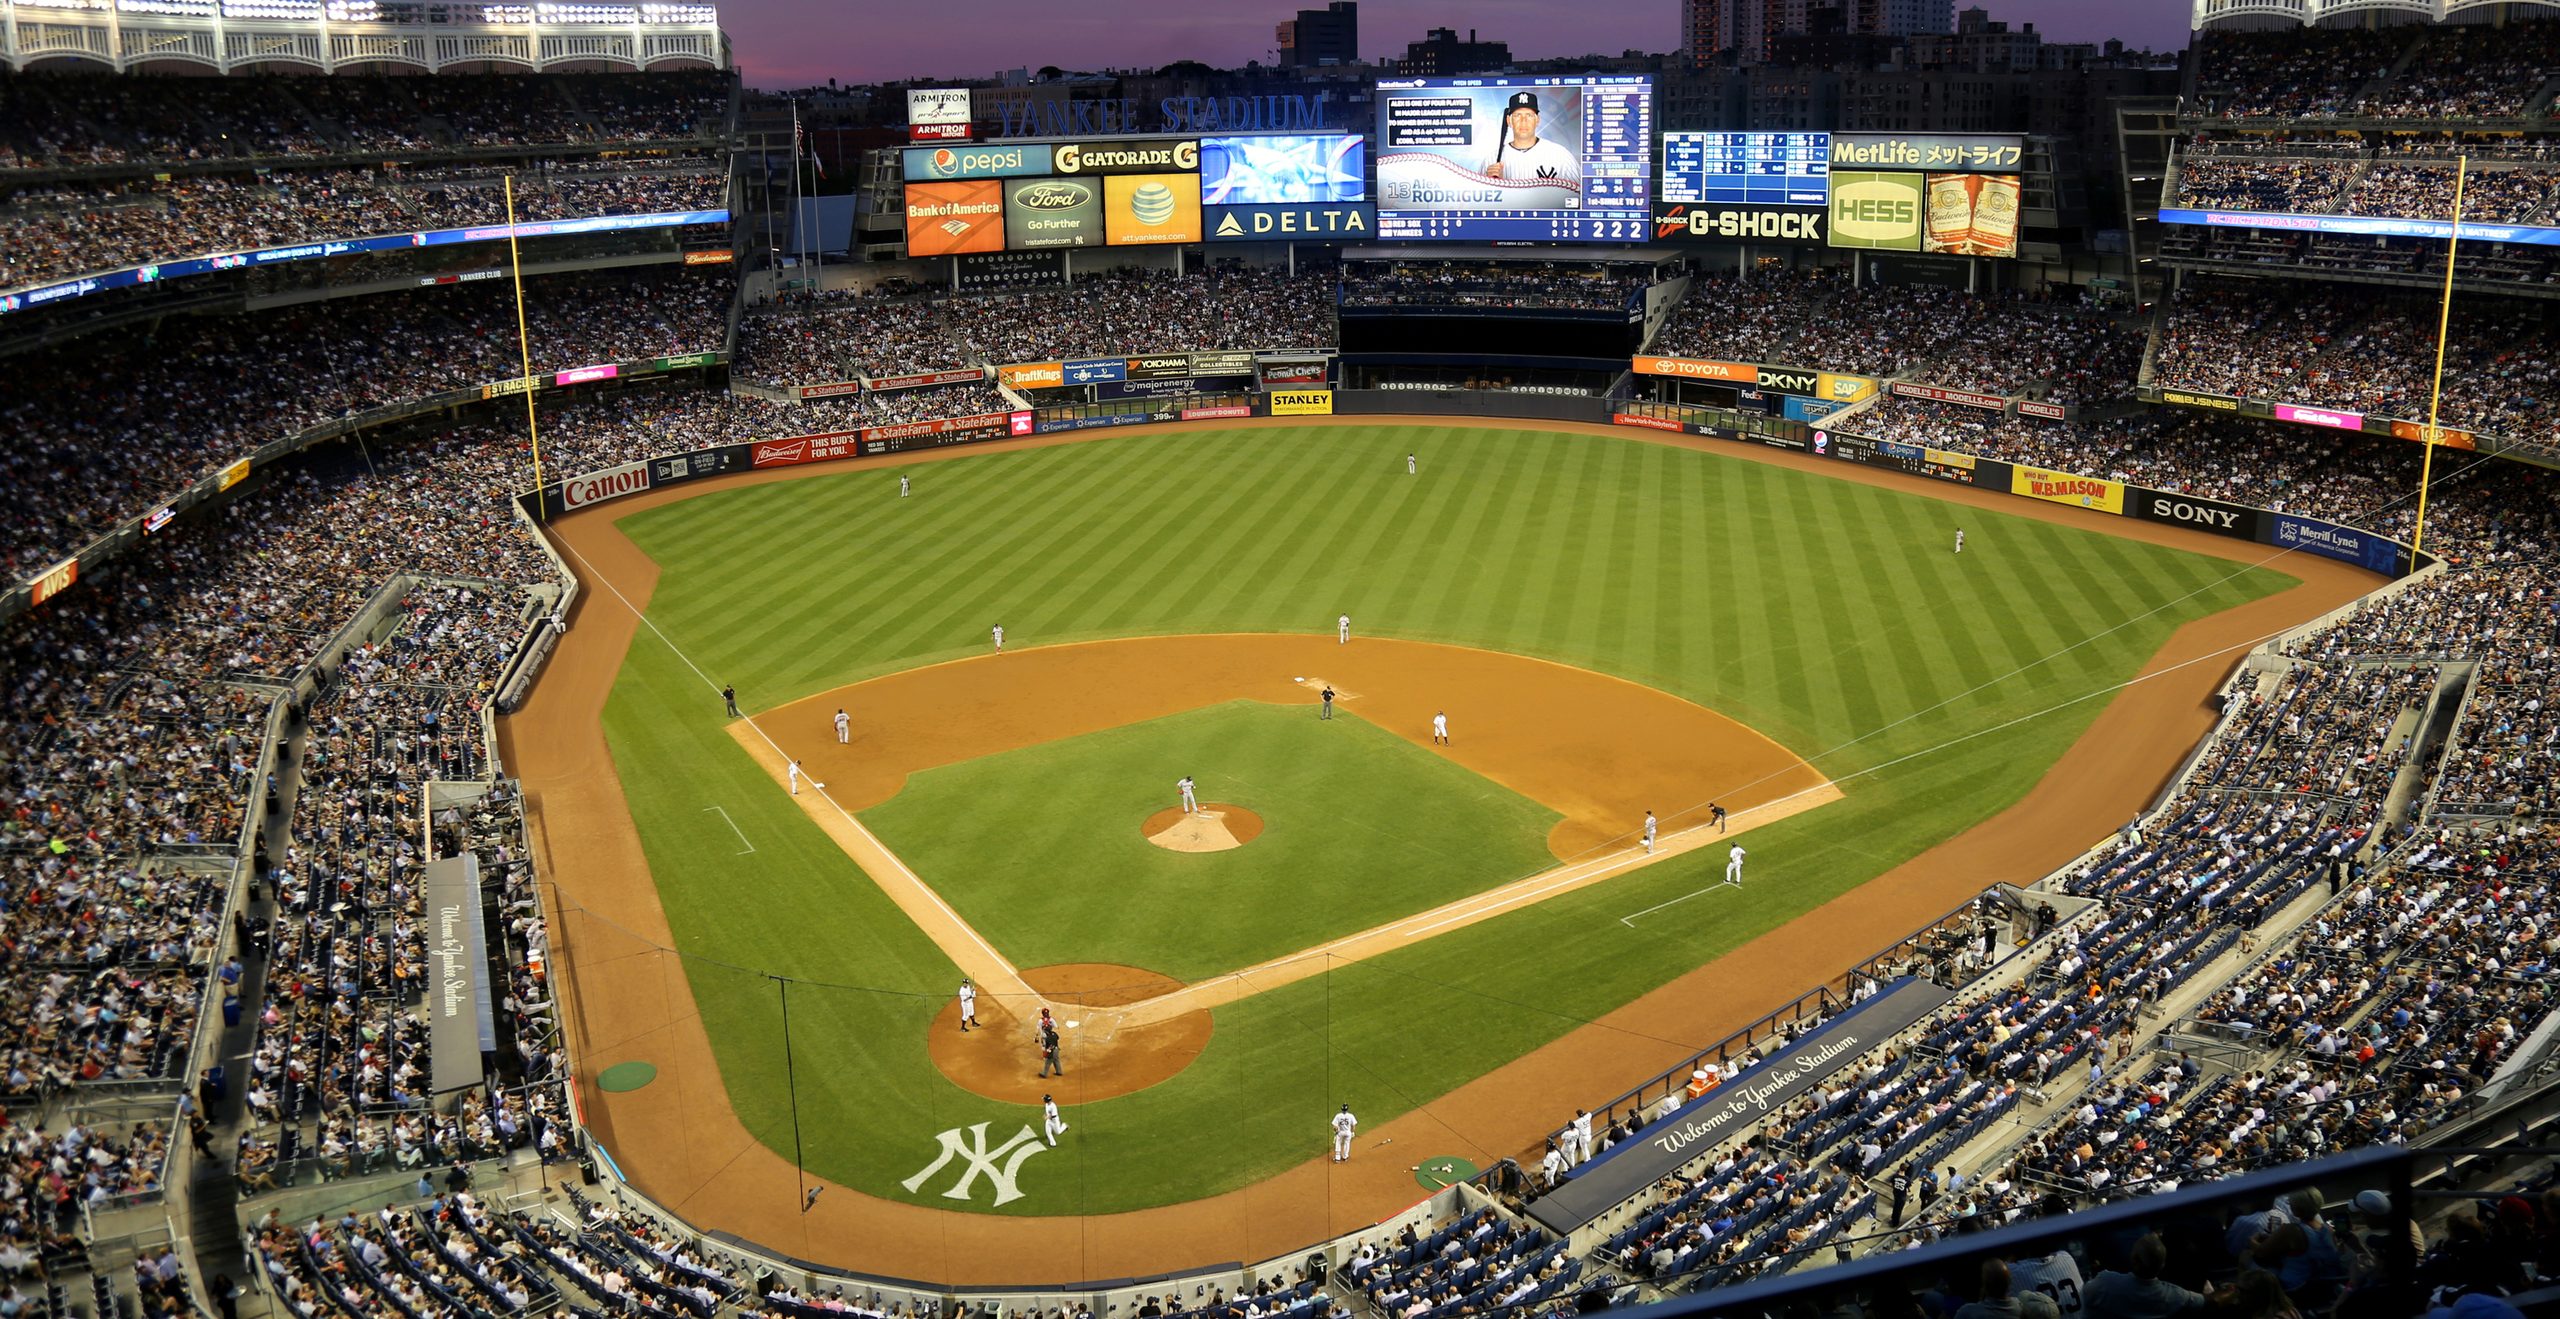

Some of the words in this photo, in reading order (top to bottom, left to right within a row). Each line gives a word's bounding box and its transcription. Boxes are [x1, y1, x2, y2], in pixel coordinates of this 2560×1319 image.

[913, 94, 967, 103] ARMITRON
[996, 98, 1139, 136] YANKEE
[1161, 95, 1325, 133] STADIUM
[917, 125, 966, 134] ARMITRON
[1082, 150, 1171, 167] GATORADE
[1834, 141, 1920, 165] MetLife
[1926, 145, 2022, 165] メットライフ
[963, 149, 1022, 174] pepsi
[1388, 182, 1411, 199] 13
[1412, 179, 1440, 189] Alex
[1029, 187, 1075, 207] Ford
[1412, 190, 1503, 203] RODRIGUEZ
[909, 204, 938, 218] Bank
[938, 203, 953, 216] of
[952, 202, 1000, 215] America
[1839, 199, 1914, 224] HESS
[1028, 220, 1044, 230] Go
[1045, 219, 1080, 229] Further
[1254, 210, 1365, 233] DELTA
[1655, 216, 1688, 224] G-SHOCK
[1689, 210, 1821, 240] G-SHOCK
[1393, 229, 1423, 237] YANKEES
[1593, 221, 1604, 238] 2
[1611, 221, 1622, 238] 2
[1630, 222, 1642, 238] 2
[2412, 225, 2433, 234] YOU
[2466, 228, 2511, 239] MATTRESS
[1025, 237, 1072, 246] tristateford.com
[1122, 232, 1186, 242] att.yankees.com
[685, 254, 733, 264] Budweiser
[459, 273, 486, 282] YANKEES
[486, 270, 502, 279] CLUB
[1141, 358, 1187, 368] YOKOHAMA
[1677, 362, 1729, 377] TOYOTA
[1015, 369, 1061, 383] DraftKings
[1267, 368, 1294, 379] Peanut
[1296, 365, 1321, 376] Chews
[491, 376, 541, 393] SYRACUSE
[1758, 372, 1817, 392] DKNY
[1834, 382, 1857, 395] SAP
[1274, 395, 1329, 405] STANLEY
[1741, 389, 1764, 401] FedEx
[1896, 385, 1932, 397] MODELL'S
[1945, 391, 2001, 408] MODELLS.com
[2184, 395, 2238, 410] BUSINESS
[1218, 408, 1245, 416] DONUTS
[2022, 403, 2060, 417] MODELL'S
[1049, 423, 1071, 432] Experian
[1084, 419, 1106, 427] Experian
[1121, 416, 1143, 425] Experian
[1624, 416, 1678, 430] NewYork-Presbyterian
[810, 438, 829, 448] THIS
[830, 434, 855, 445] BUD'S
[1842, 437, 1868, 447] GATORADE
[760, 448, 801, 459] Budweiser
[811, 449, 827, 458] FOR
[828, 447, 848, 456] YOU.
[1896, 445, 1916, 455] pepsi
[2023, 471, 2037, 480] WHO
[2037, 472, 2049, 481] BUT
[565, 467, 648, 506] Canon
[2031, 480, 2107, 499] W.B.MASON
[2153, 499, 2239, 529] SONY
[2300, 525, 2331, 542] Merrill
[2332, 533, 2359, 550] Lynch
[2316, 541, 2335, 551] America
[2335, 545, 2360, 557] Corporation
[40, 566, 71, 601] AVIS
[439, 904, 461, 941] Welcome
[431, 945, 465, 979] Yankee
[444, 979, 466, 1018] Stadium
[1654, 1110, 1734, 1154] Welcome
[1727, 1098, 1748, 1115] to
[1738, 1067, 1801, 1111] Yankee
[1795, 1034, 1859, 1073] Stadium
